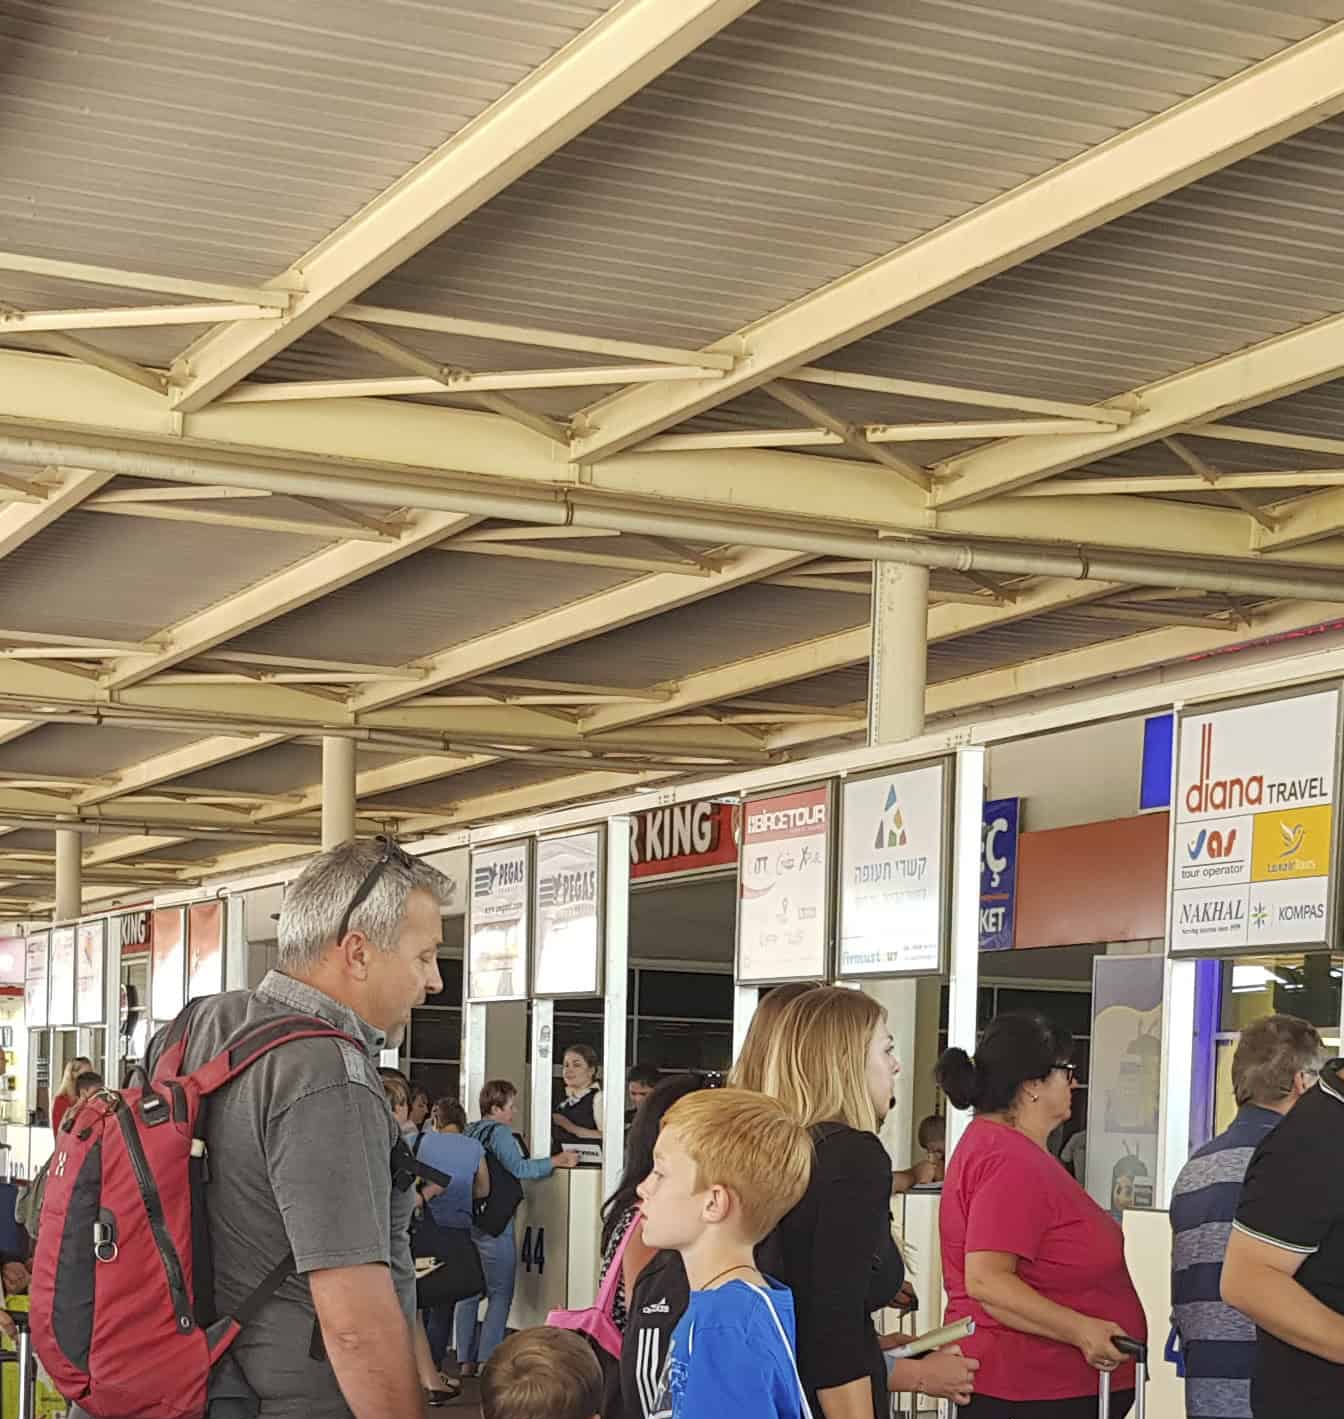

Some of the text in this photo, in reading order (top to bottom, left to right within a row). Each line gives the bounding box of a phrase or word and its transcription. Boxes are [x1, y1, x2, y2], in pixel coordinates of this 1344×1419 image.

[1267, 775, 1329, 805] TRAVEL
[645, 801, 713, 862] KING
[498, 860, 524, 887] PEGAS
[563, 870, 595, 902] PEGAS
[1181, 864, 1244, 879] tour operator
[1179, 899, 1244, 925] NAKHAL
[1278, 903, 1324, 921] KOMPAS
[120, 912, 146, 945] KING
[521, 1226, 545, 1275] 44
